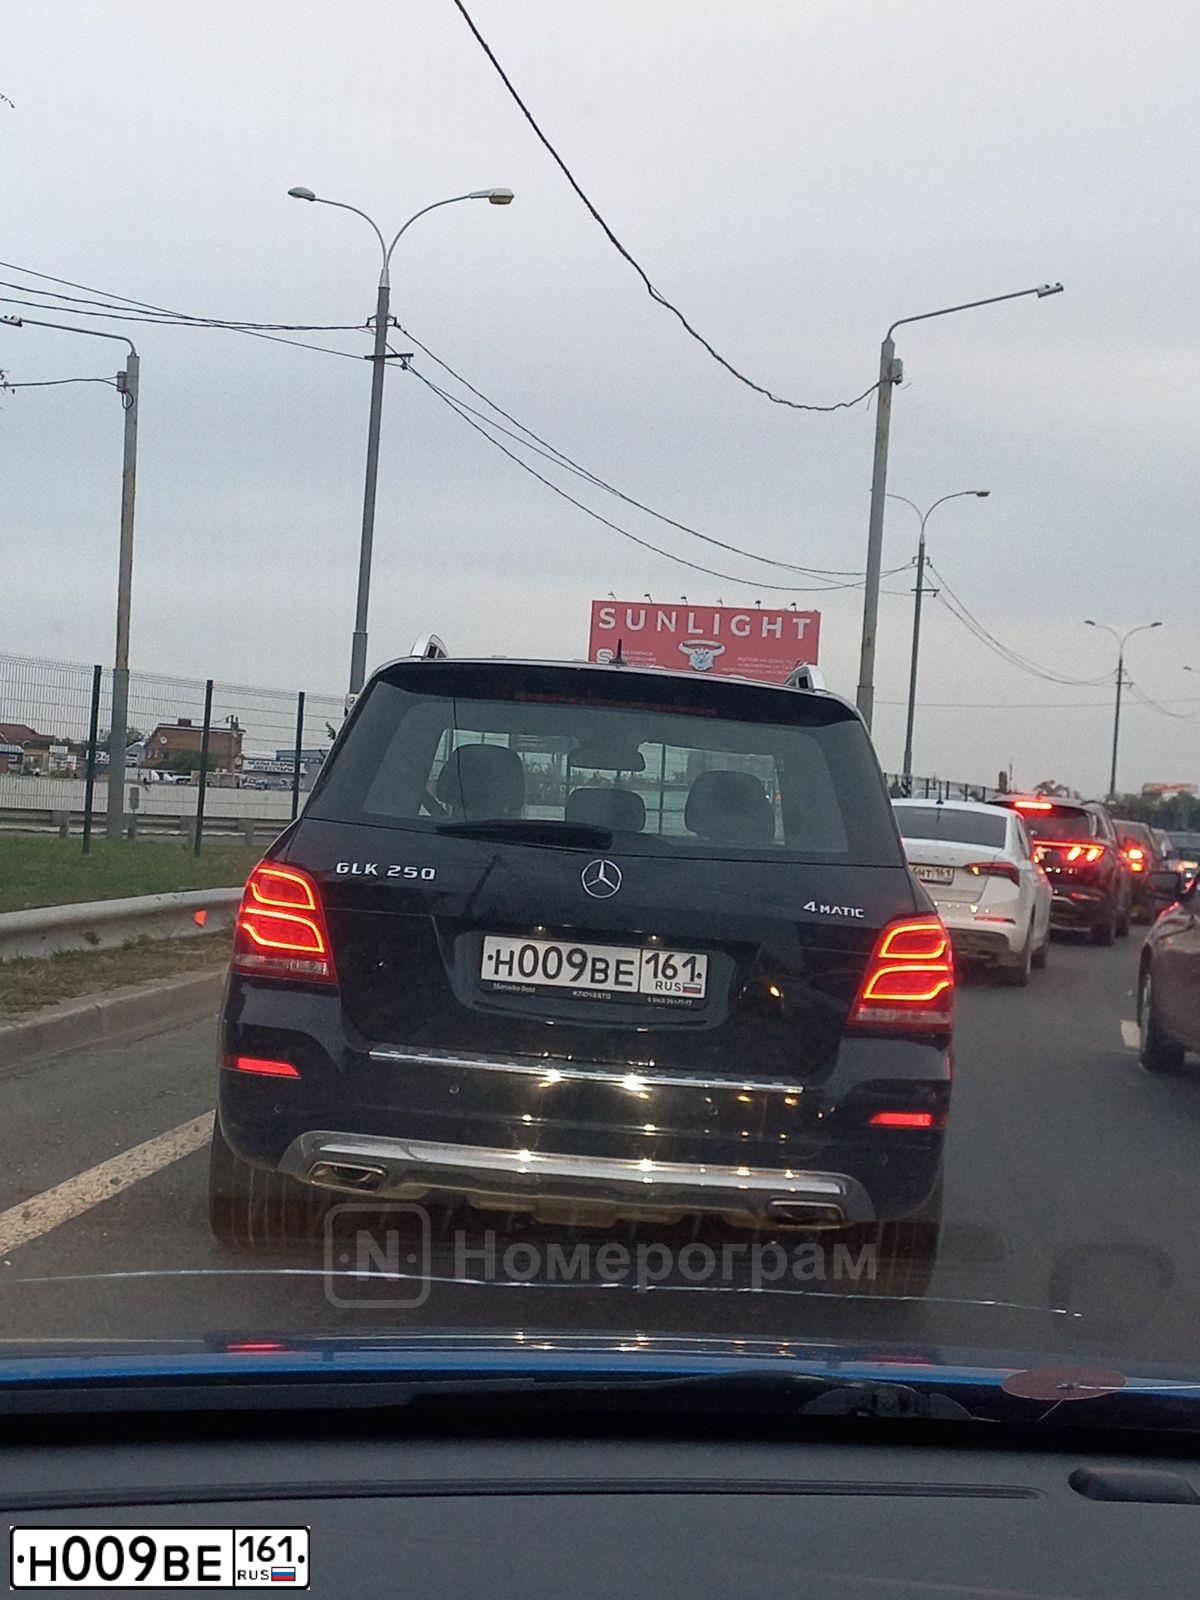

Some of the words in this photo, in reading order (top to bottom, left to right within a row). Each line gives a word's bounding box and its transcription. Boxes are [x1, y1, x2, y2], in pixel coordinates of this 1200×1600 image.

[599, 607, 812, 640] SUNLIGHT
[336, 862, 379, 876] GLK
[386, 864, 436, 880] 250
[493, 943, 635, 986] Н009ВЕ
[644, 952, 697, 982] 161
[655, 980, 682, 992] RUS
